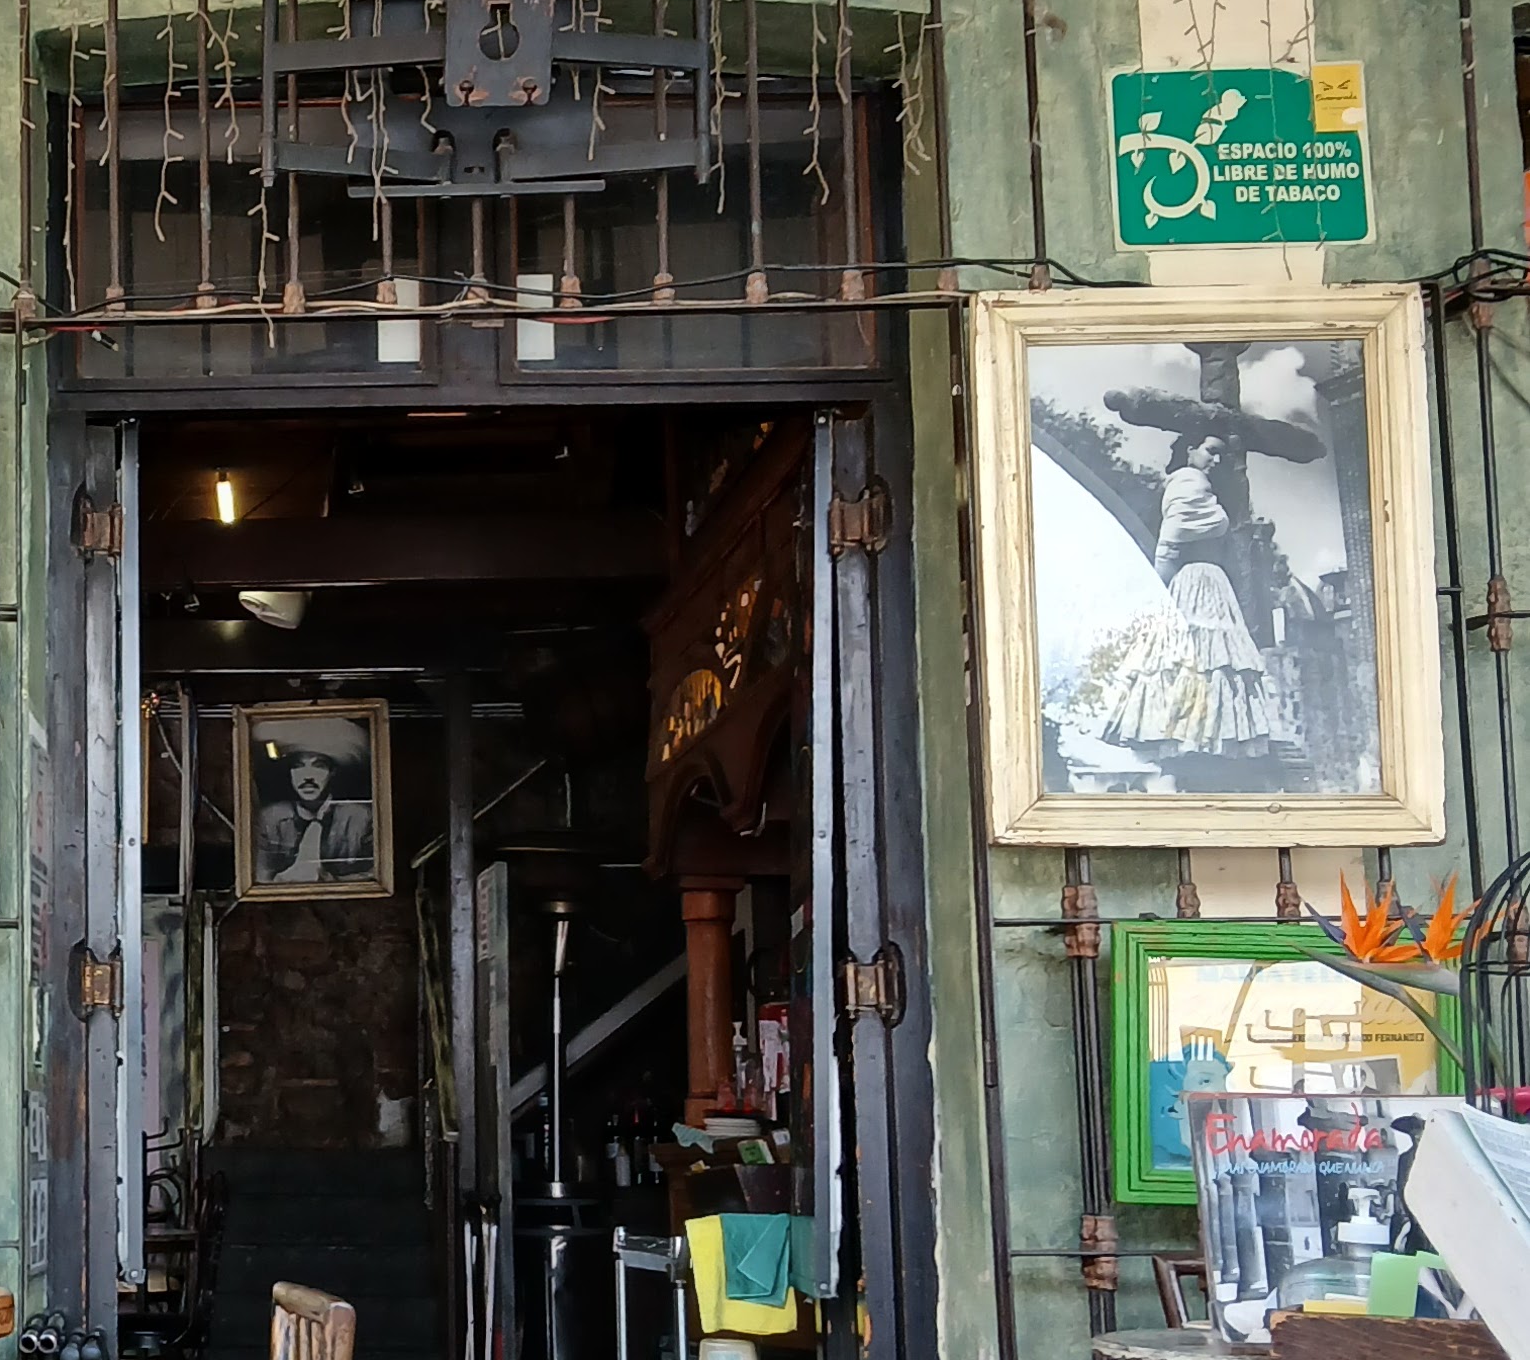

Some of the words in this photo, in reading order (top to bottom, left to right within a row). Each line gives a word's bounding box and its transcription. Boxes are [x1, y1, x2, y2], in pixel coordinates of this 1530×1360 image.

[1218, 143, 1297, 160] ESPACIO
[1302, 141, 1352, 158] 100%
[1213, 165, 1268, 181] LIBRE
[1273, 164, 1298, 180] DE
[1303, 163, 1359, 179] HUMO
[1235, 186, 1260, 202] DE
[1265, 184, 1341, 202] TABACO
[1205, 1102, 1382, 1155] Enamorada
